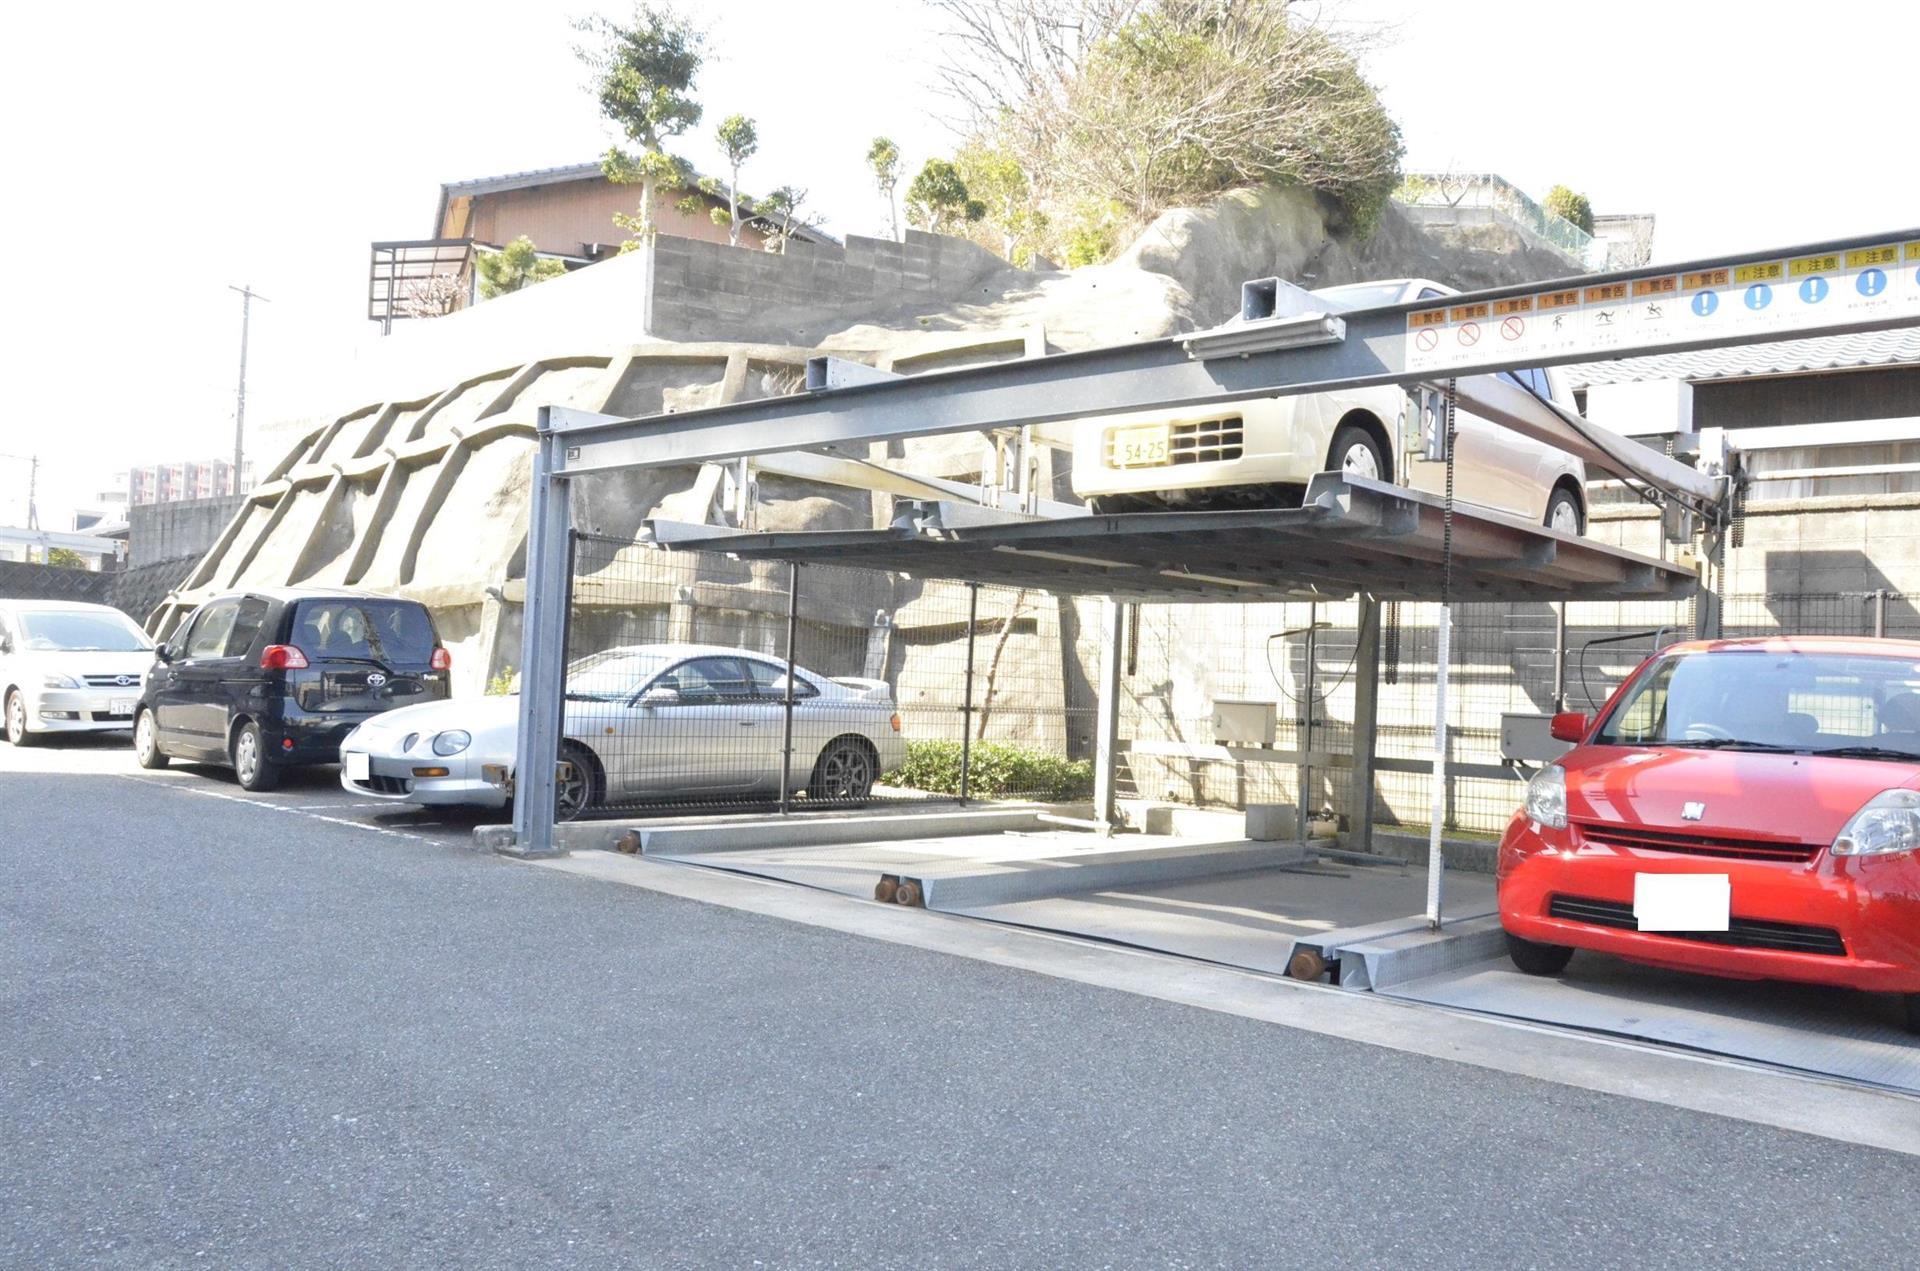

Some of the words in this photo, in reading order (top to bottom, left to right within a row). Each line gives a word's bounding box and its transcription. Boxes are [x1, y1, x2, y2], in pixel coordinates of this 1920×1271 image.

[1865, 248, 1894, 264] 注意
[1753, 264, 1780, 279] 注意
[1807, 257, 1836, 272] 注意
[1701, 271, 1726, 285] 警告
[1601, 285, 1625, 298] 警告
[1126, 441, 1164, 461] 54-25
